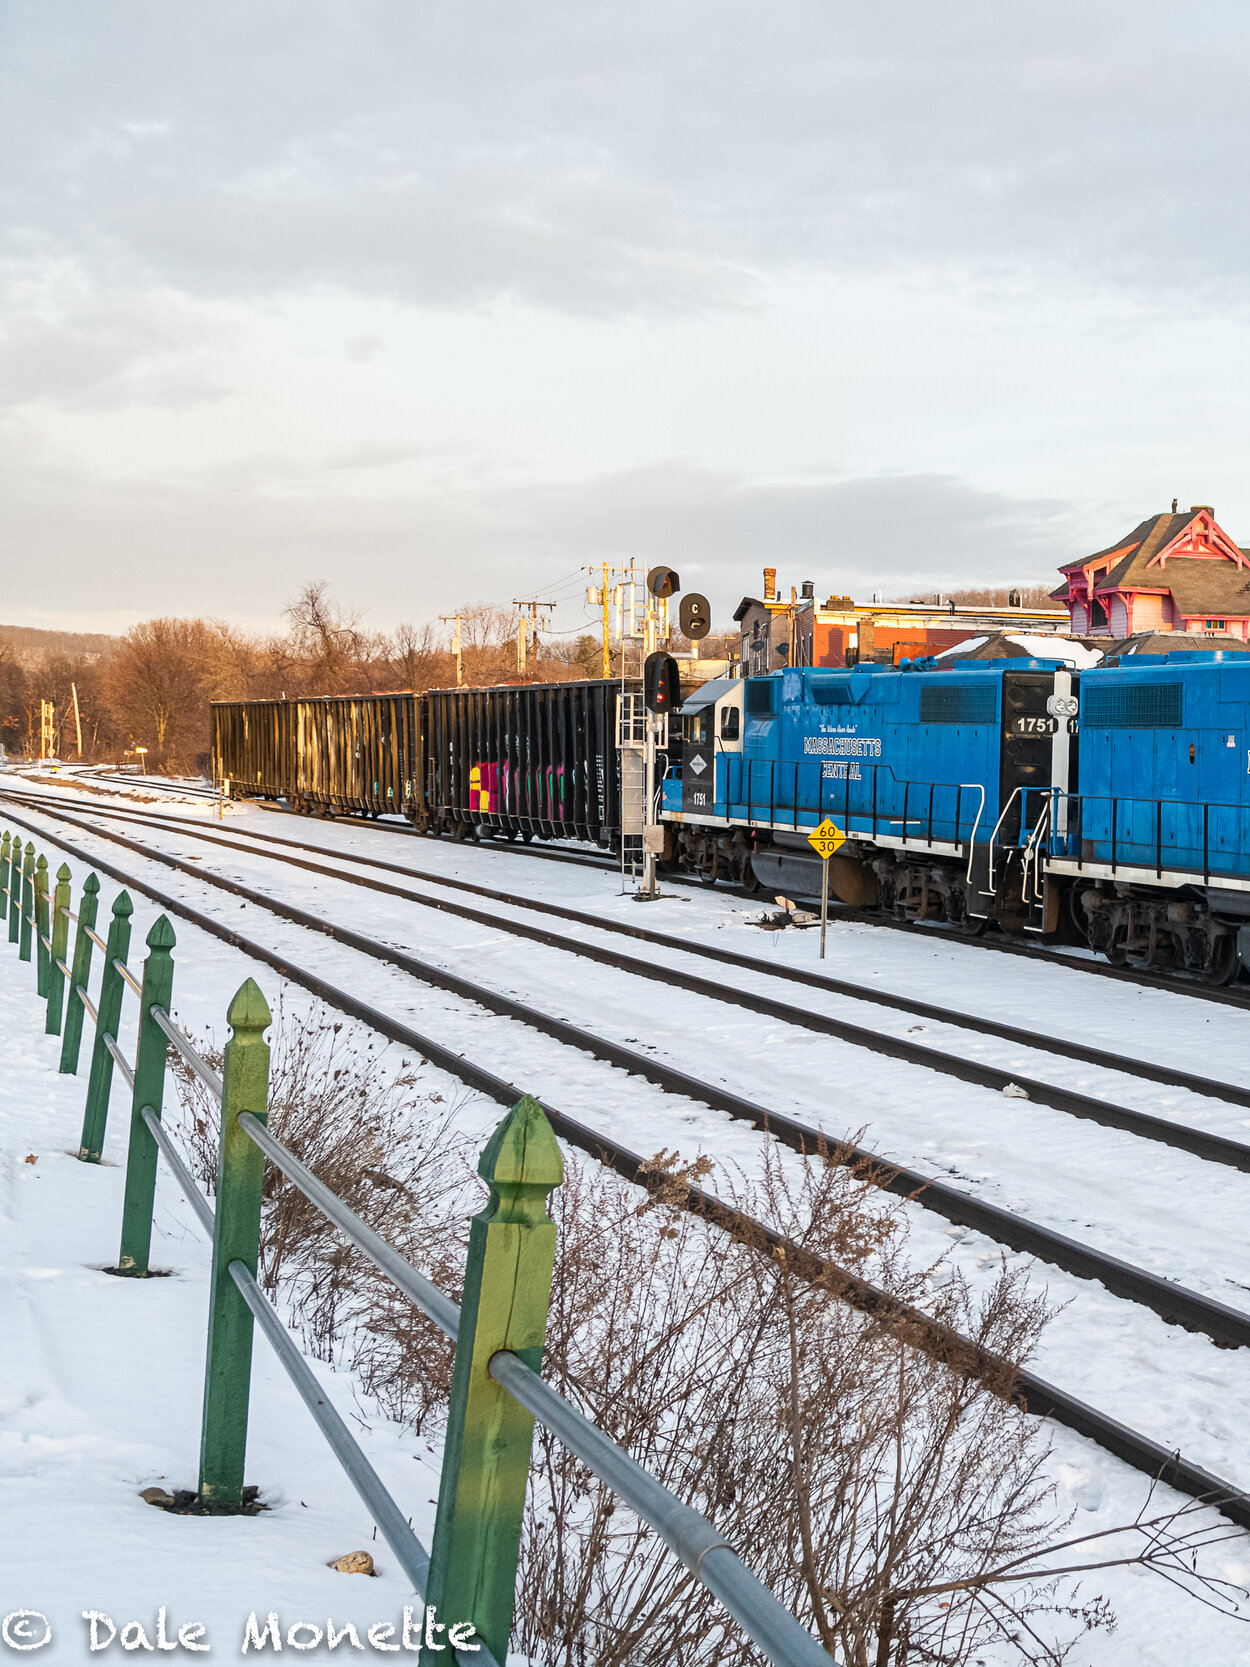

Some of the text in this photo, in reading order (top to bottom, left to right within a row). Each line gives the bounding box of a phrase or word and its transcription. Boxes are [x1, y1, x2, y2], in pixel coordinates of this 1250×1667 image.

[691, 603, 699, 614] C
[1017, 717, 1054, 732] 1751
[803, 736, 882, 757] MASSACHUSETTS
[693, 792, 706, 806] 1751
[819, 826, 836, 838] 60
[818, 840, 835, 852] 30
